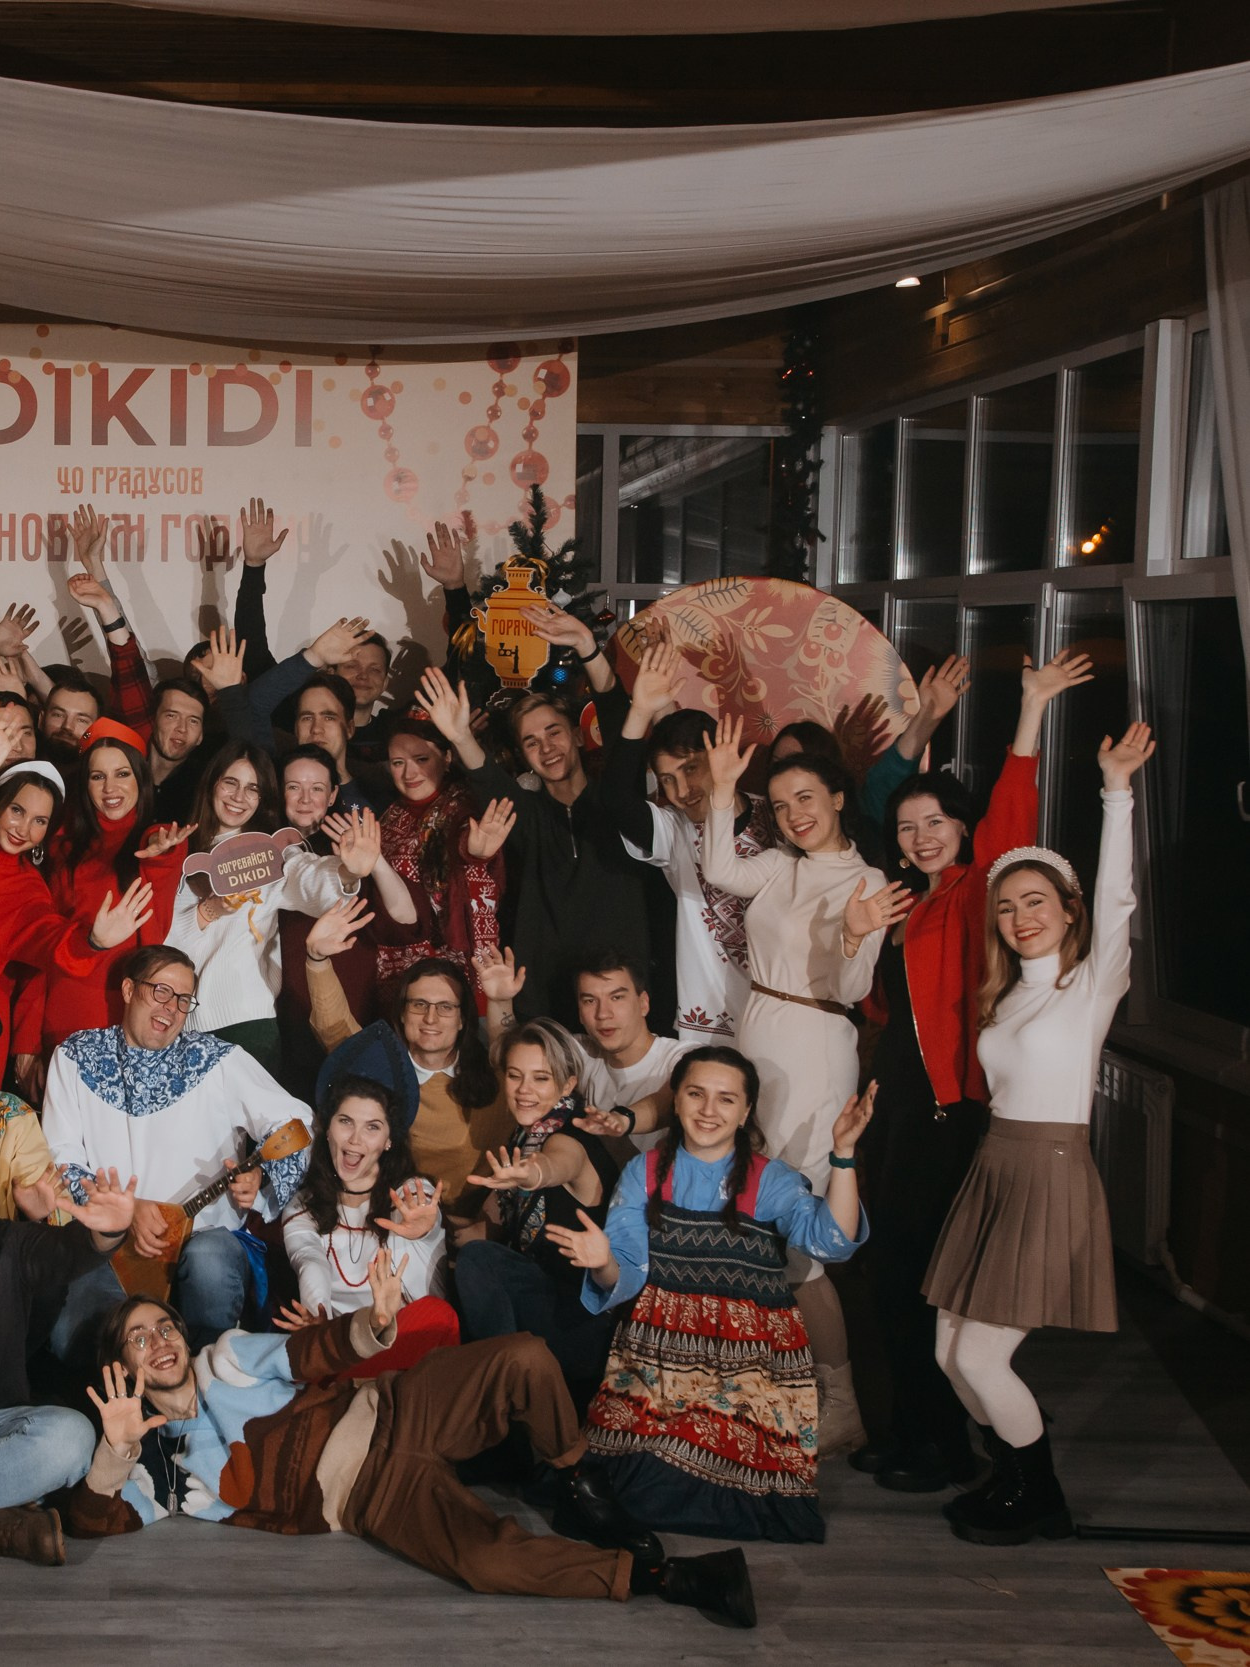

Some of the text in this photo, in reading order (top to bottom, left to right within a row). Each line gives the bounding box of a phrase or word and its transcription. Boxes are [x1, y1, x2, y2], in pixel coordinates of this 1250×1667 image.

[92, 466, 204, 499] ГРАДУСОВ
[217, 852, 268, 876] СОГРЕВАЙСЯ
[228, 866, 271, 887] DIKIDI
